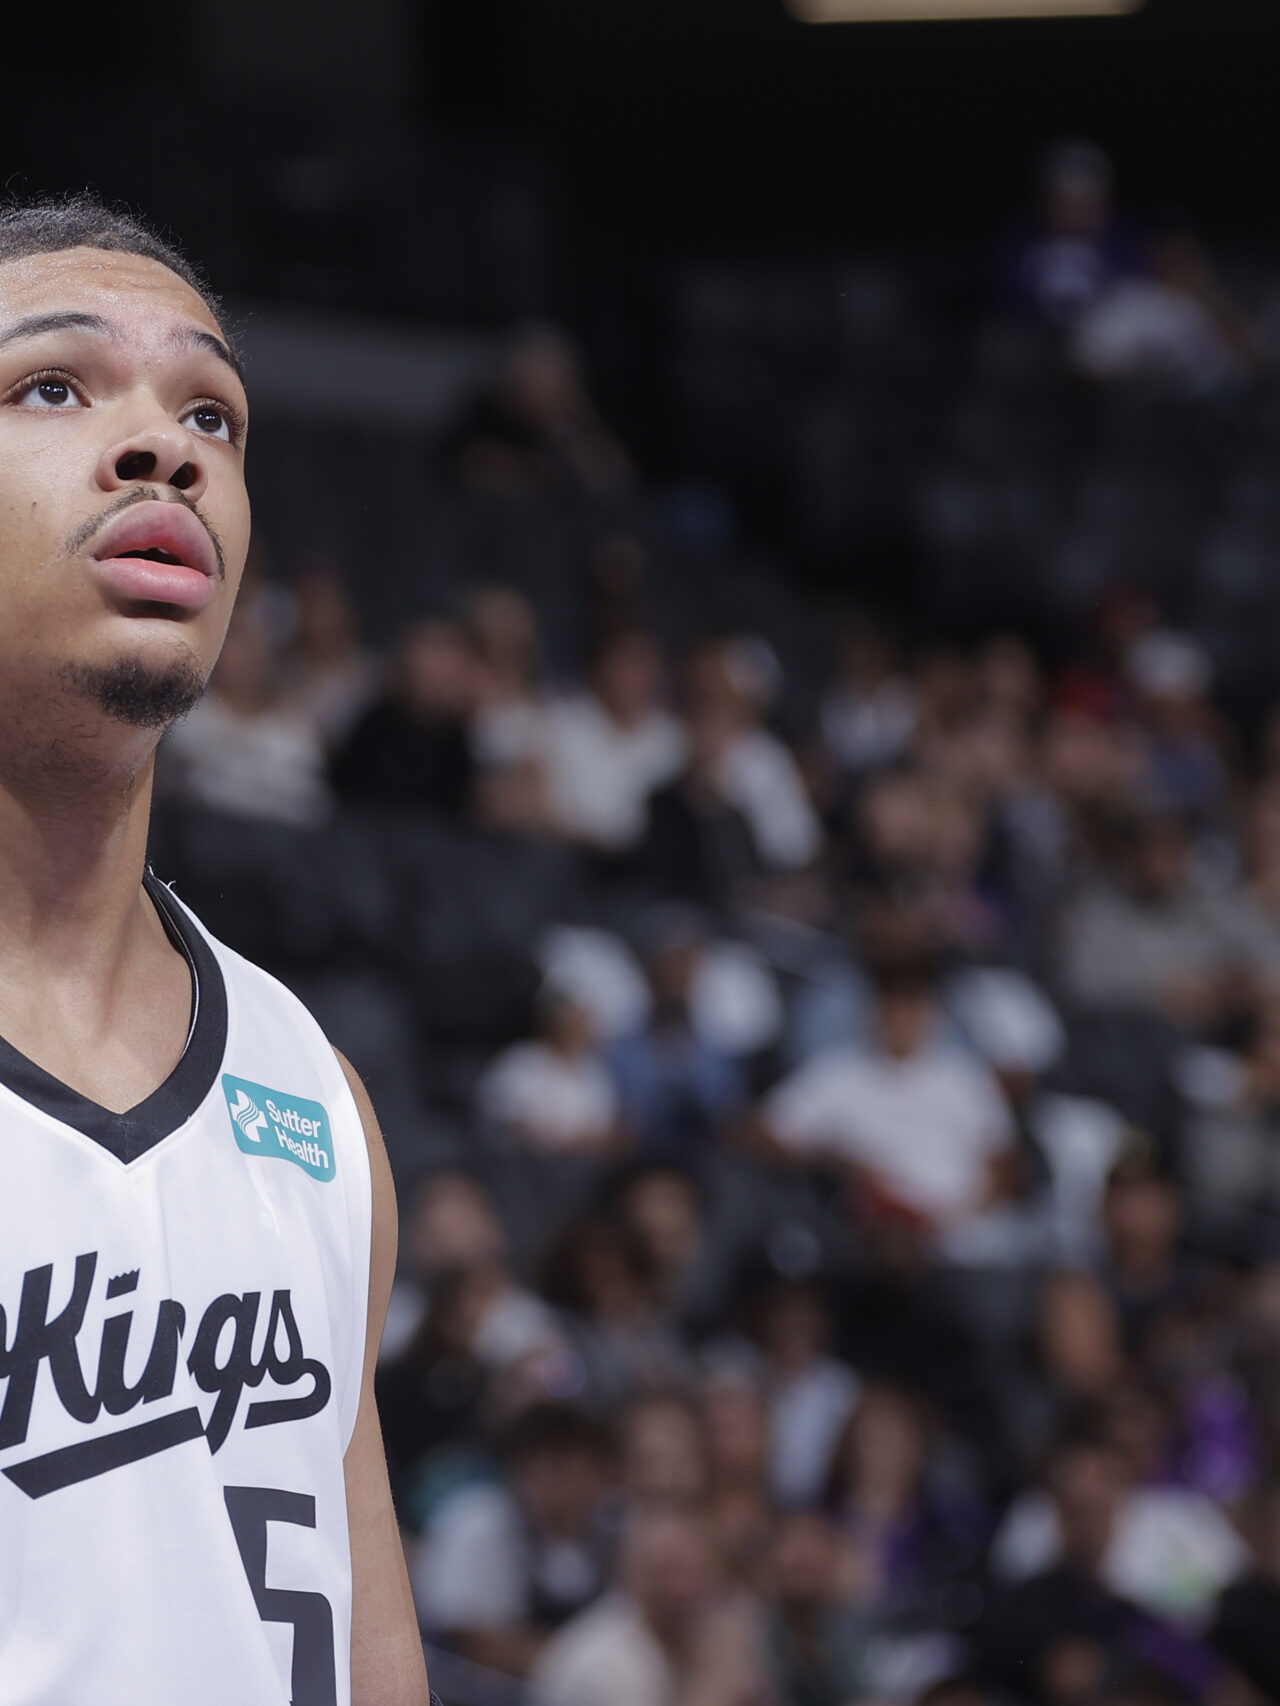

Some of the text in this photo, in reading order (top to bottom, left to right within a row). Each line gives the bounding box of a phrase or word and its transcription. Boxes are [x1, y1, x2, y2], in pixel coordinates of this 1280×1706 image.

[265, 1099, 322, 1138] Sutter
[274, 1125, 329, 1169] Health
[223, 1485, 338, 1706] 5
